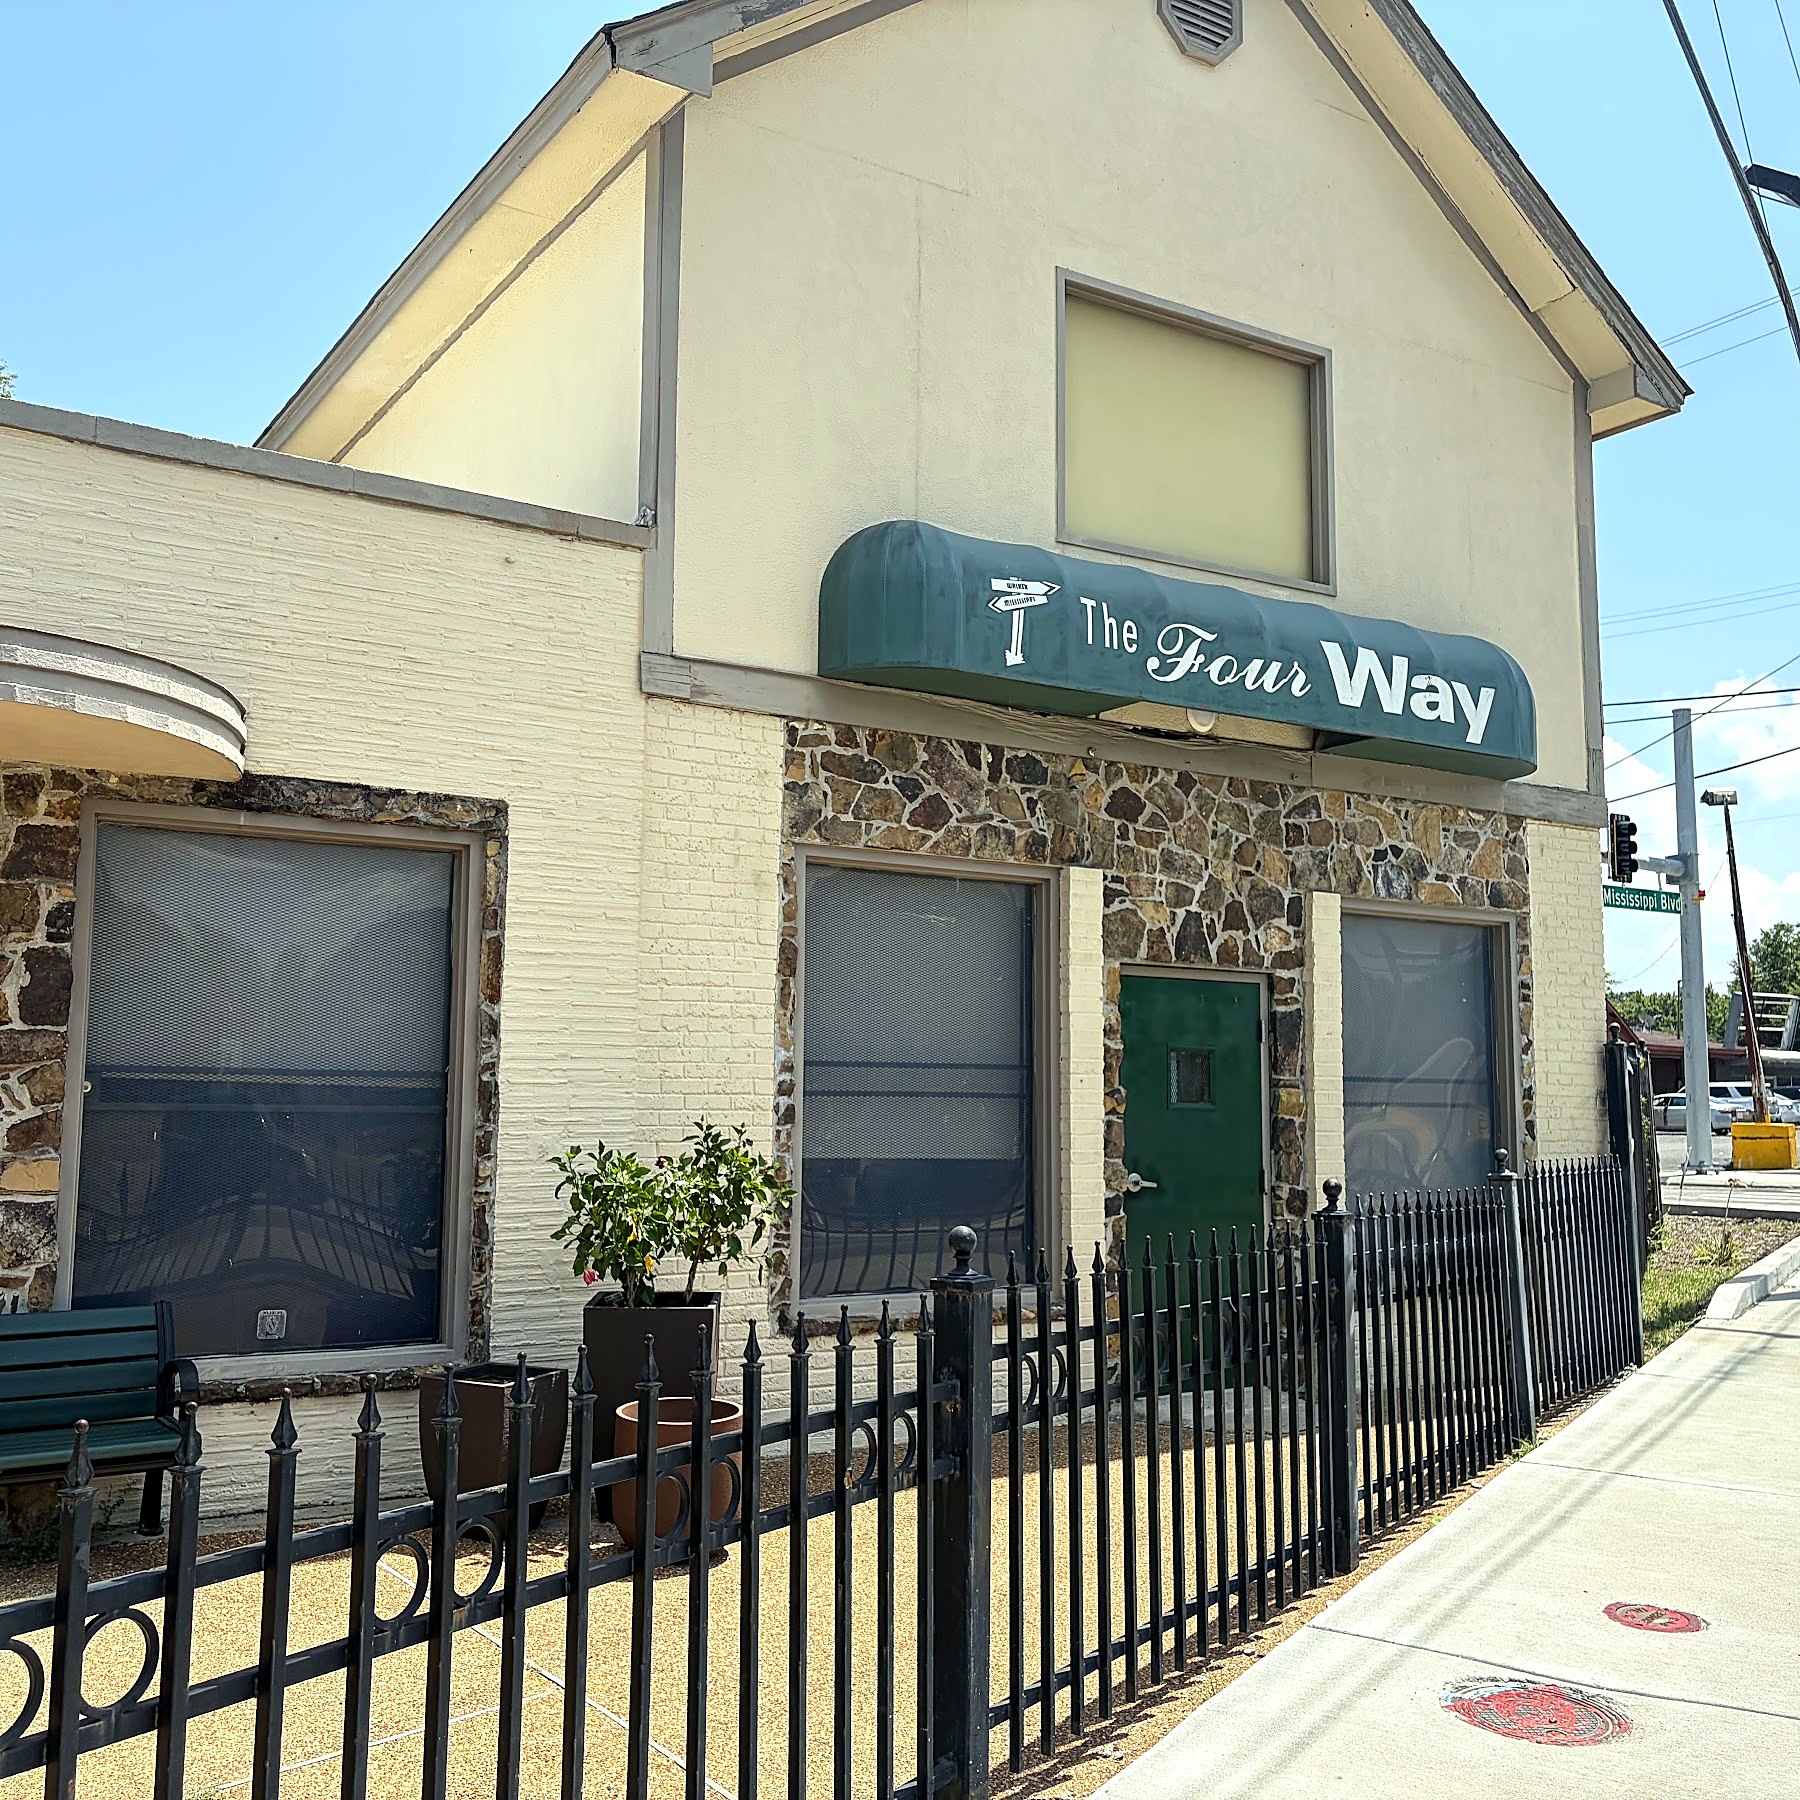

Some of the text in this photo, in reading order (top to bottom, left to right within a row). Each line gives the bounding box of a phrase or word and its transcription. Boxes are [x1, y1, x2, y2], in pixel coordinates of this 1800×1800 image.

[1079, 596, 1495, 745] The Four Way
[1603, 887, 1681, 912] Mississippi Blvd
